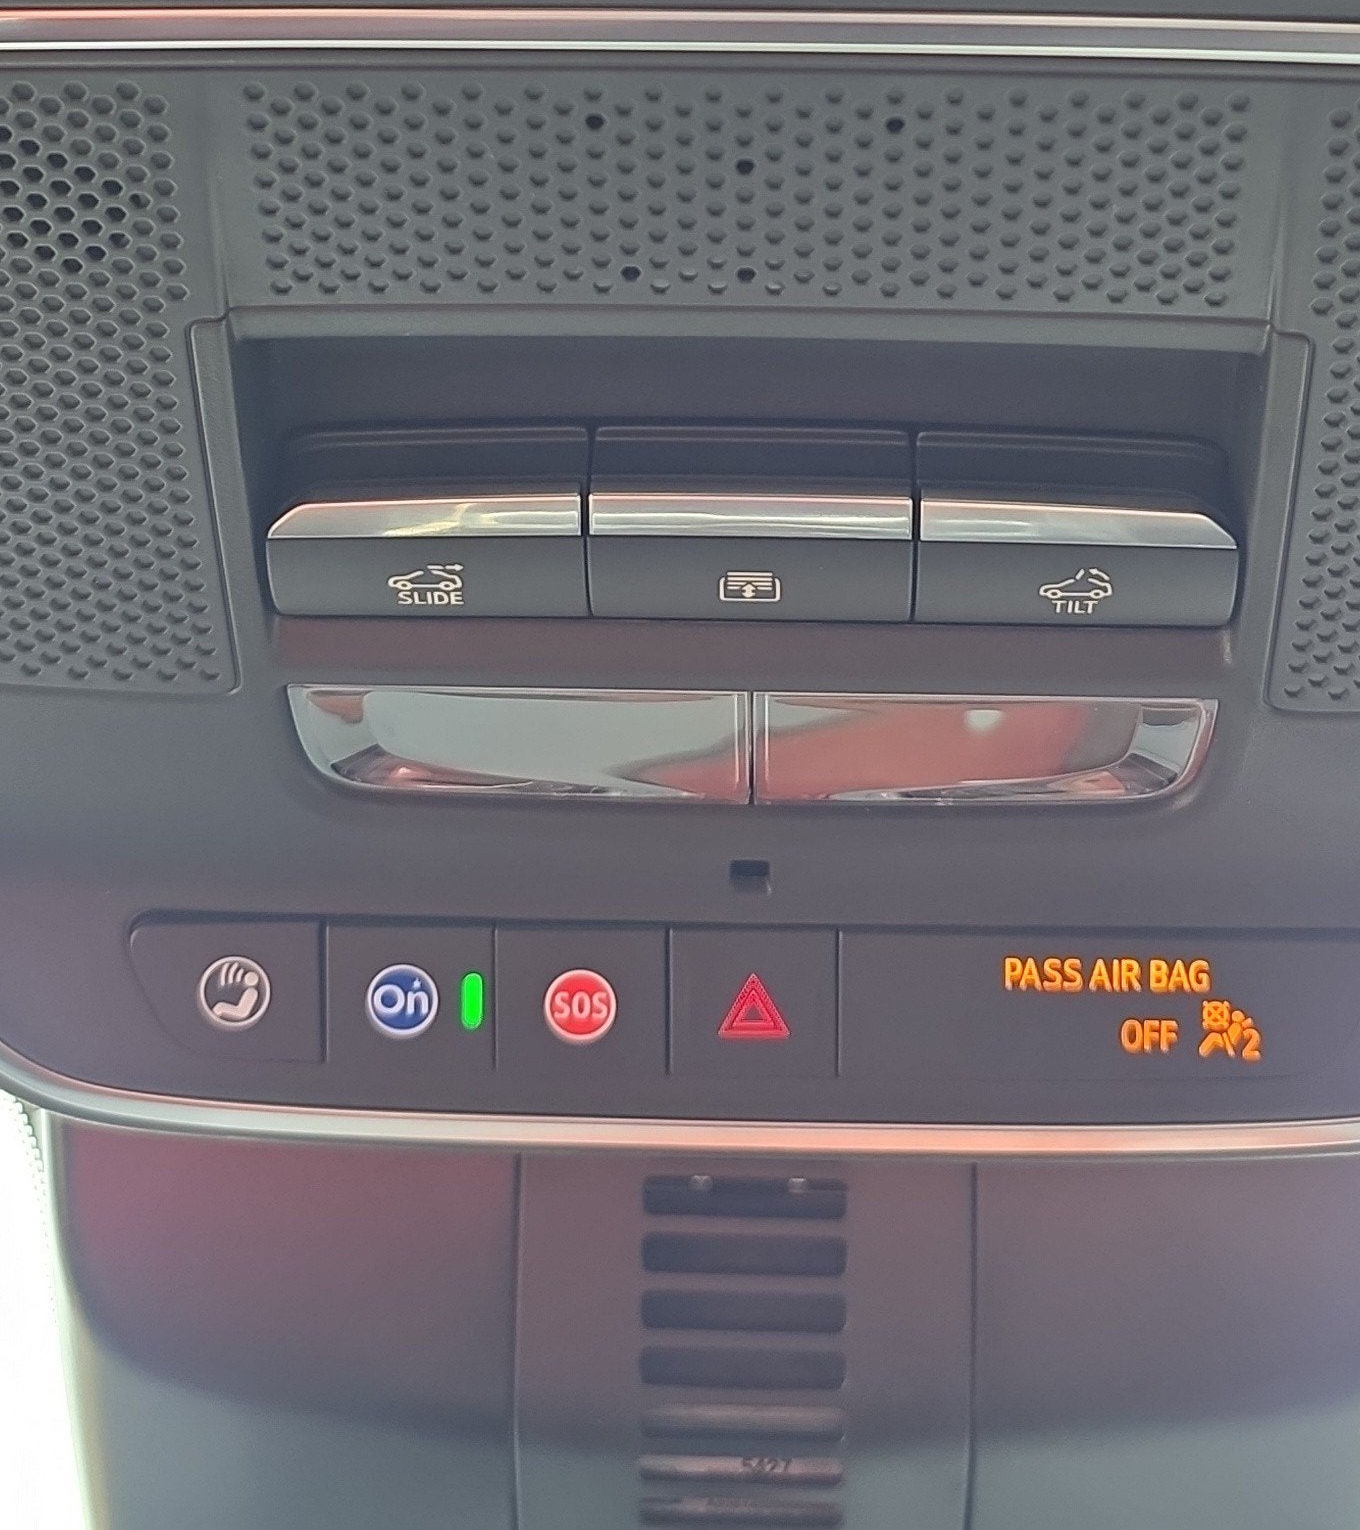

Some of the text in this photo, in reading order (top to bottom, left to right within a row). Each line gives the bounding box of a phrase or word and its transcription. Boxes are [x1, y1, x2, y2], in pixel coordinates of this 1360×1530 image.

[397, 591, 465, 606] SLIDE
[1051, 599, 1099, 614] TILT
[1003, 957, 1211, 993] PASS AIR BAG
[373, 981, 429, 1015] On
[553, 990, 609, 1019] SOS
[1120, 1019, 1179, 1054] OFF
[1242, 1027, 1262, 1061] 2
